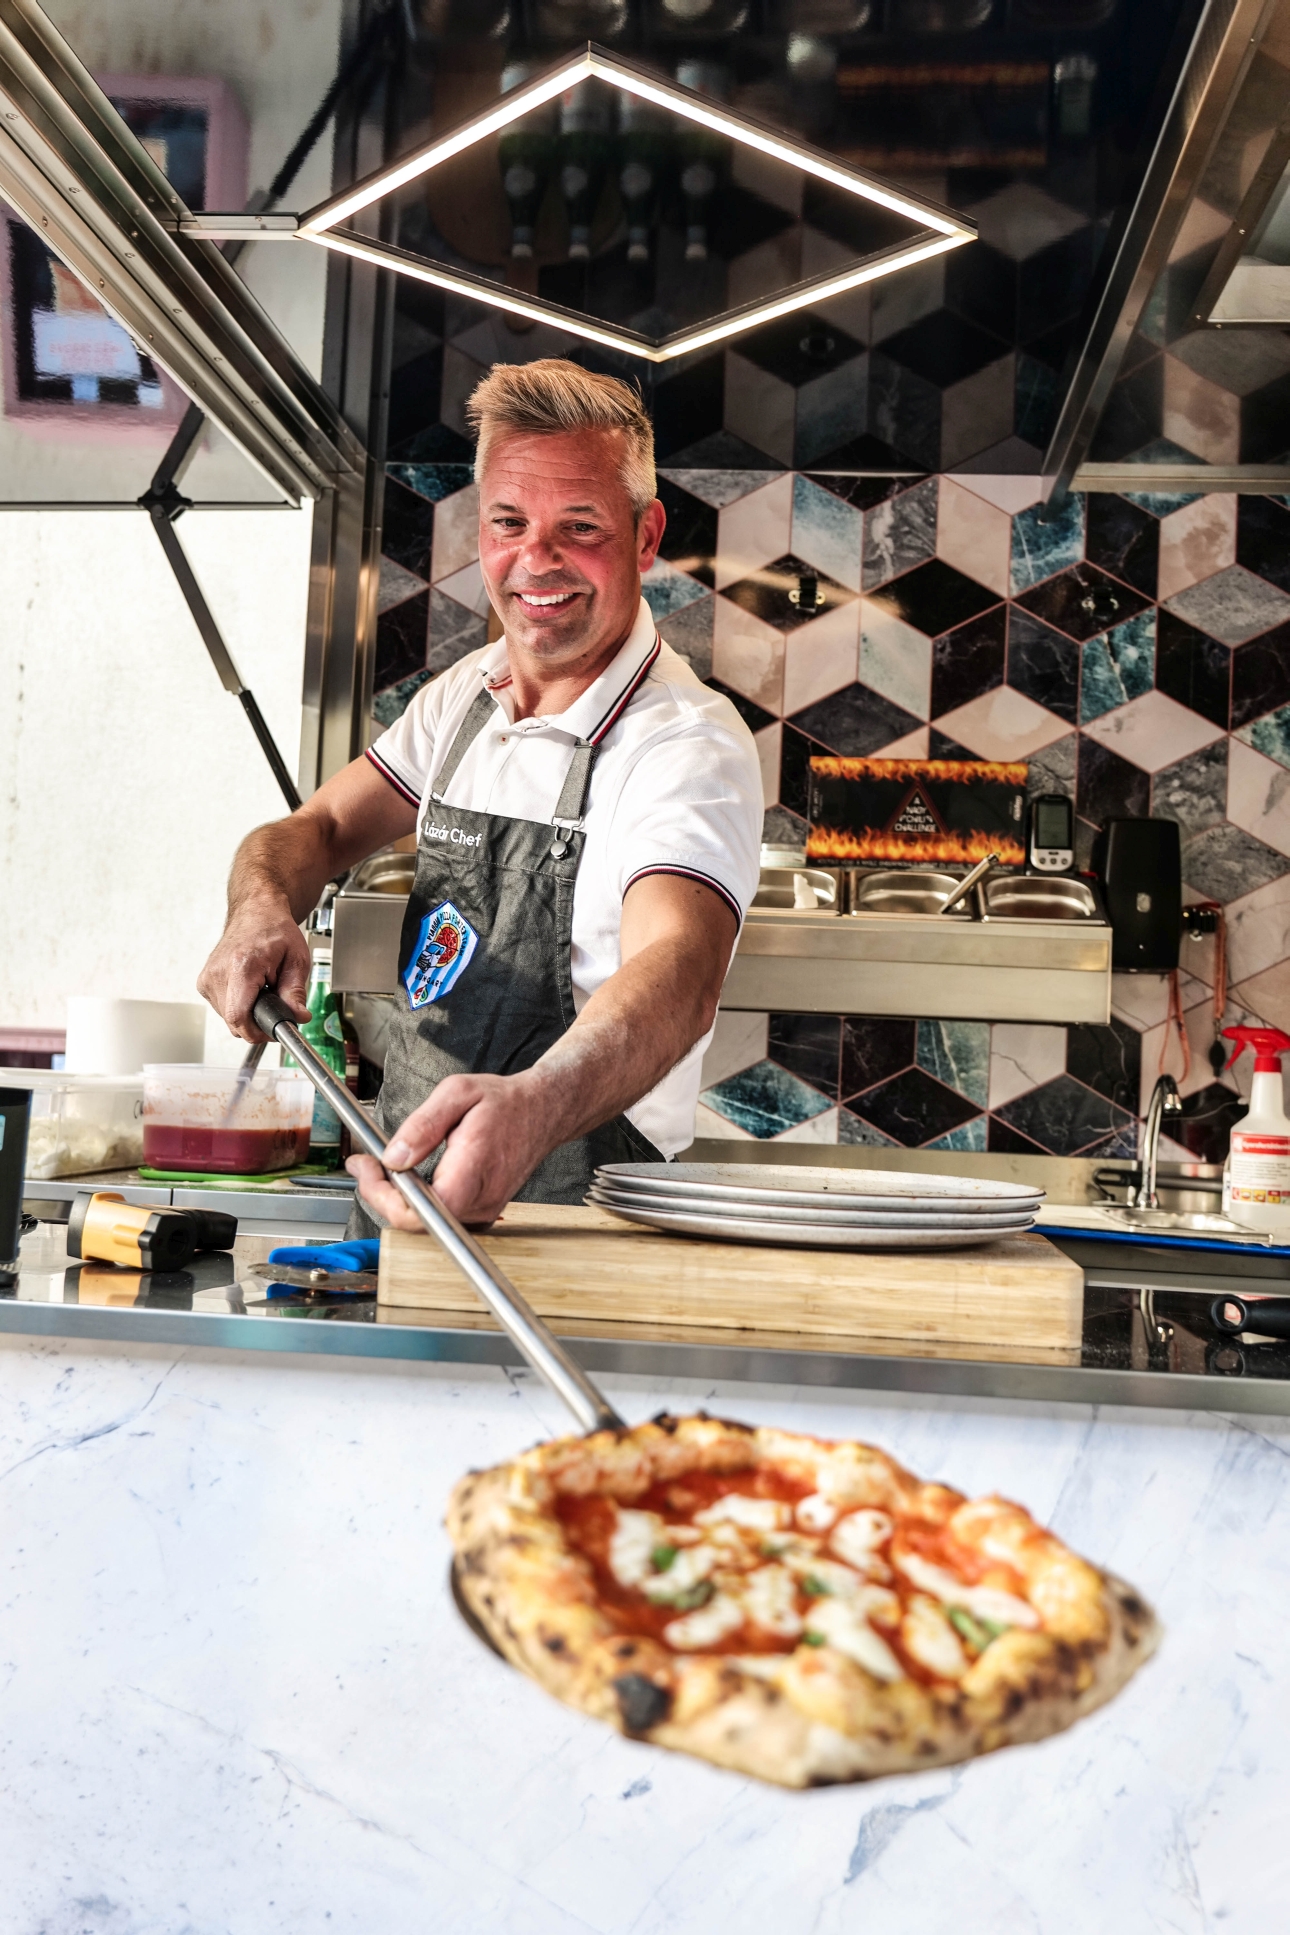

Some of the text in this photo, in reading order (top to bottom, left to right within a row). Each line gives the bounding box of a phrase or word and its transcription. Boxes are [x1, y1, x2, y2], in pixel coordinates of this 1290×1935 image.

[913, 796, 921, 805] A
[894, 823, 936, 833] CHALLENGE
[424, 821, 483, 848] Lázár Chef
[414, 973, 443, 988] HUNGARY
